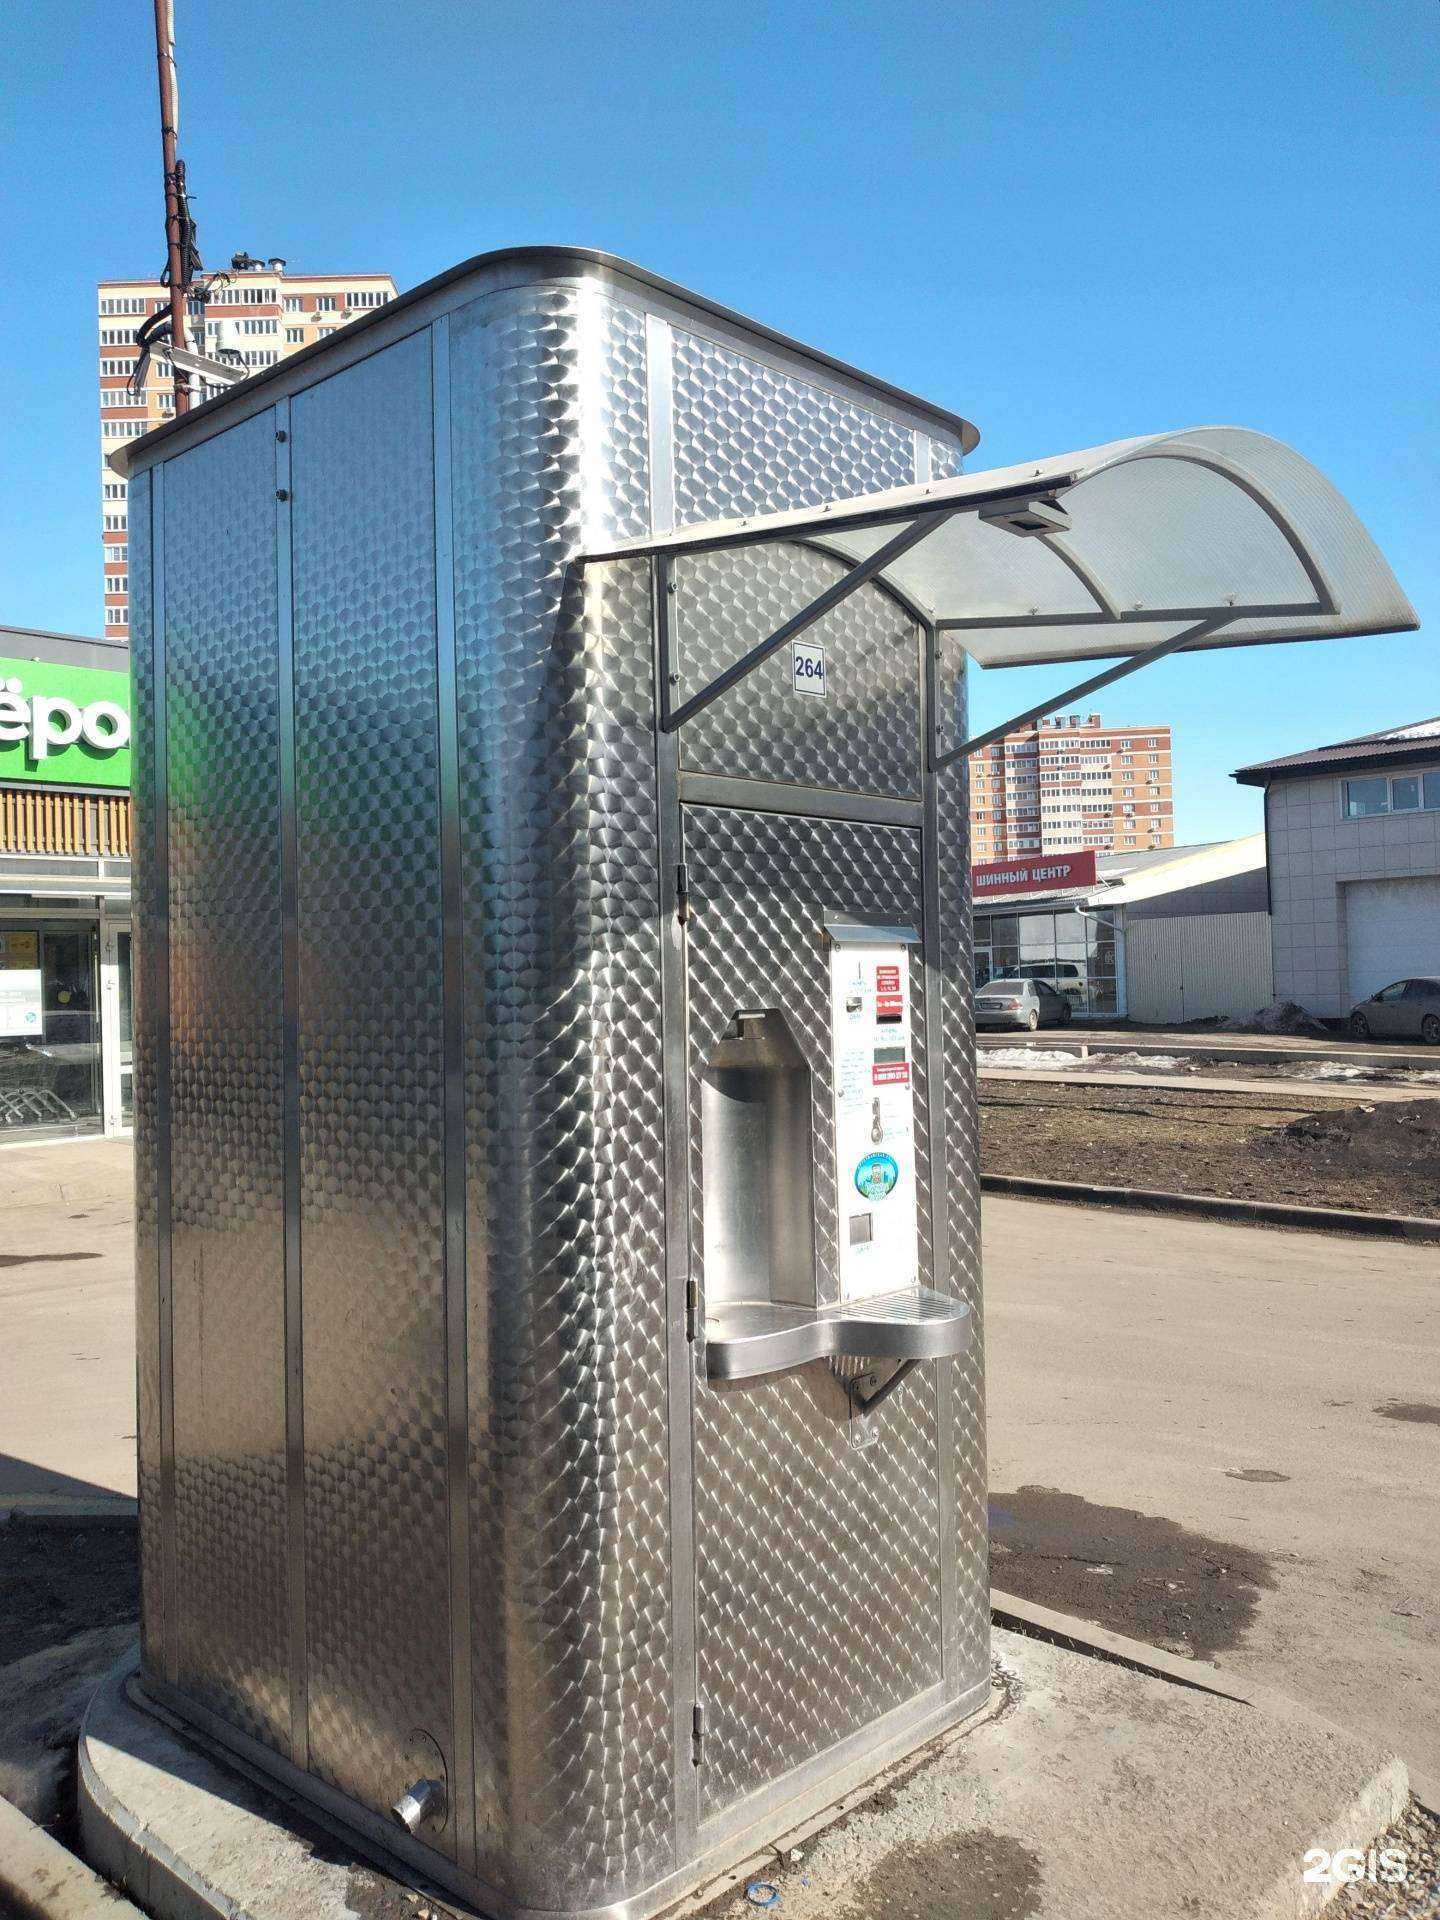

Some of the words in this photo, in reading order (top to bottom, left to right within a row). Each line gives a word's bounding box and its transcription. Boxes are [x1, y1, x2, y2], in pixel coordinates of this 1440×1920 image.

[795, 656, 824, 680] 264
[976, 868, 1028, 887] ШИННЫЙ
[1032, 864, 1072, 883] ЦЕНТР
